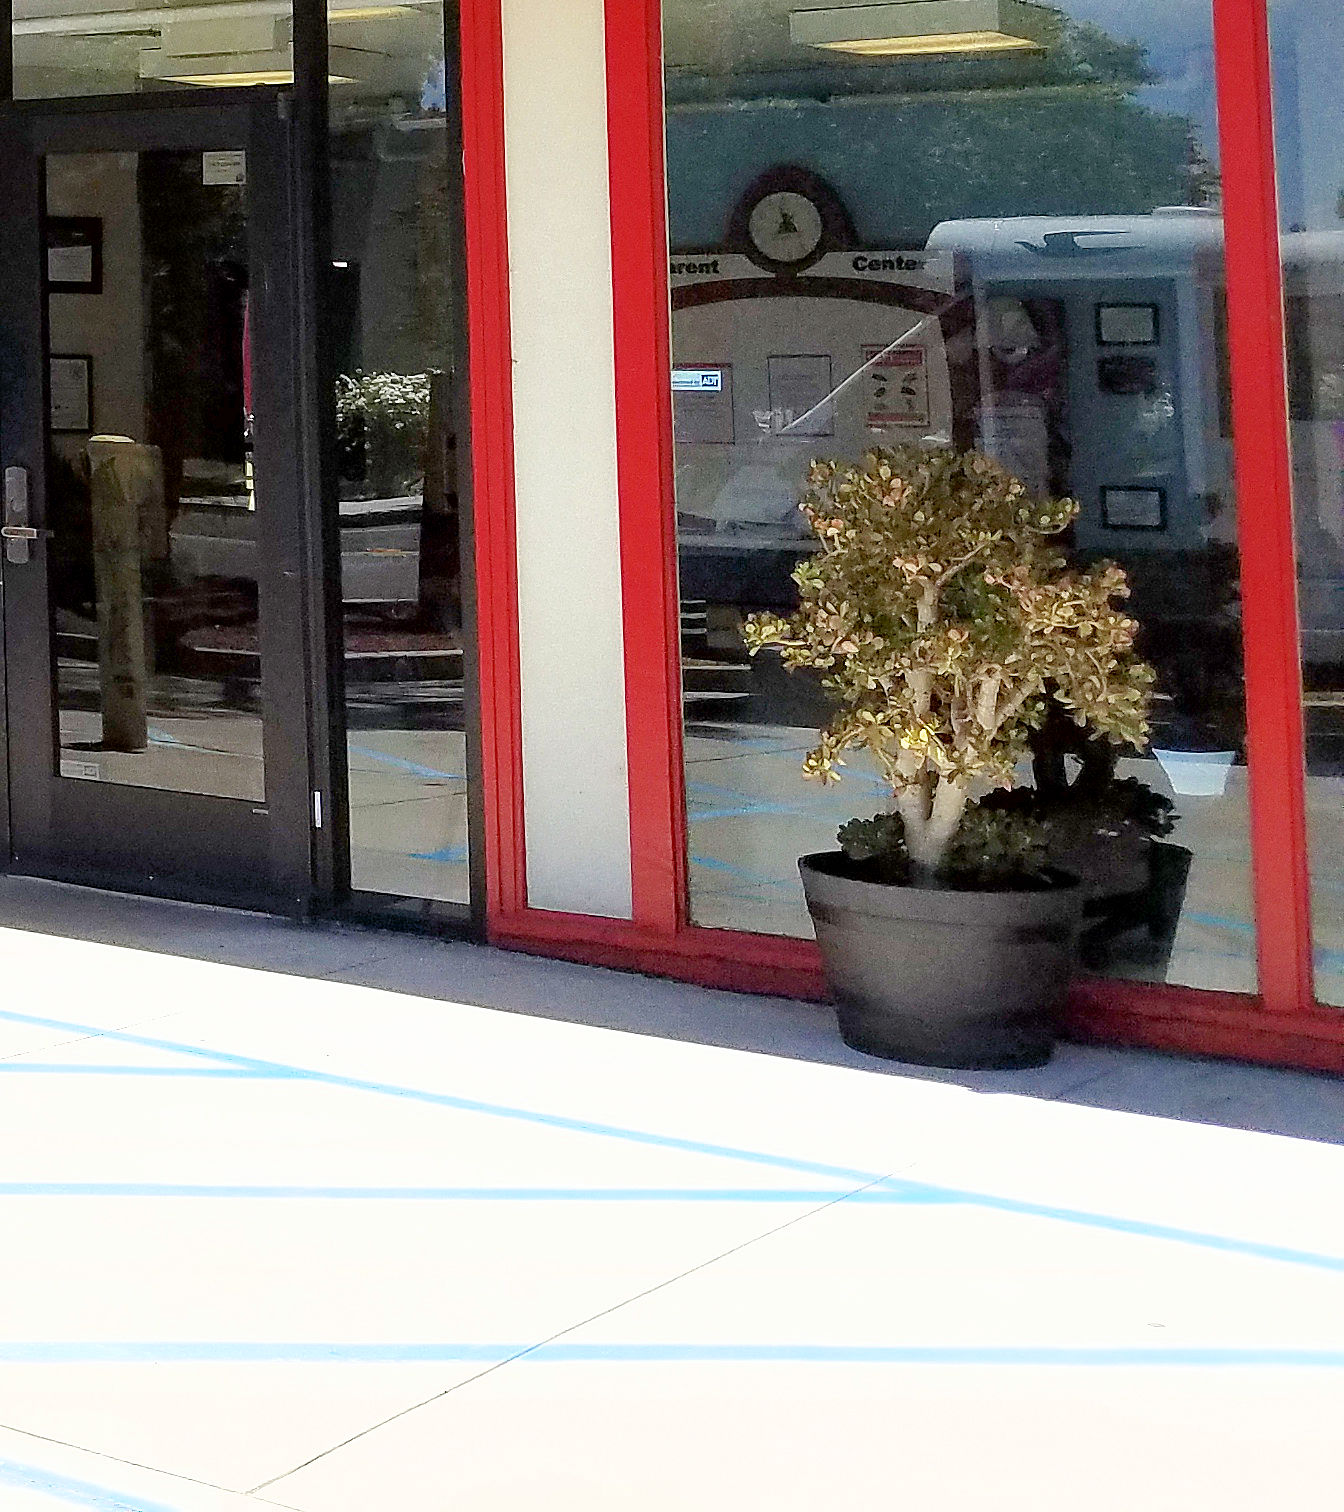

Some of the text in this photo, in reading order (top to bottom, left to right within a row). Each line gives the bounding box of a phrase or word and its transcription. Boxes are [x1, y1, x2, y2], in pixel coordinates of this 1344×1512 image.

[670, 255, 927, 275] arent Center
[703, 375, 719, 386] ADT
